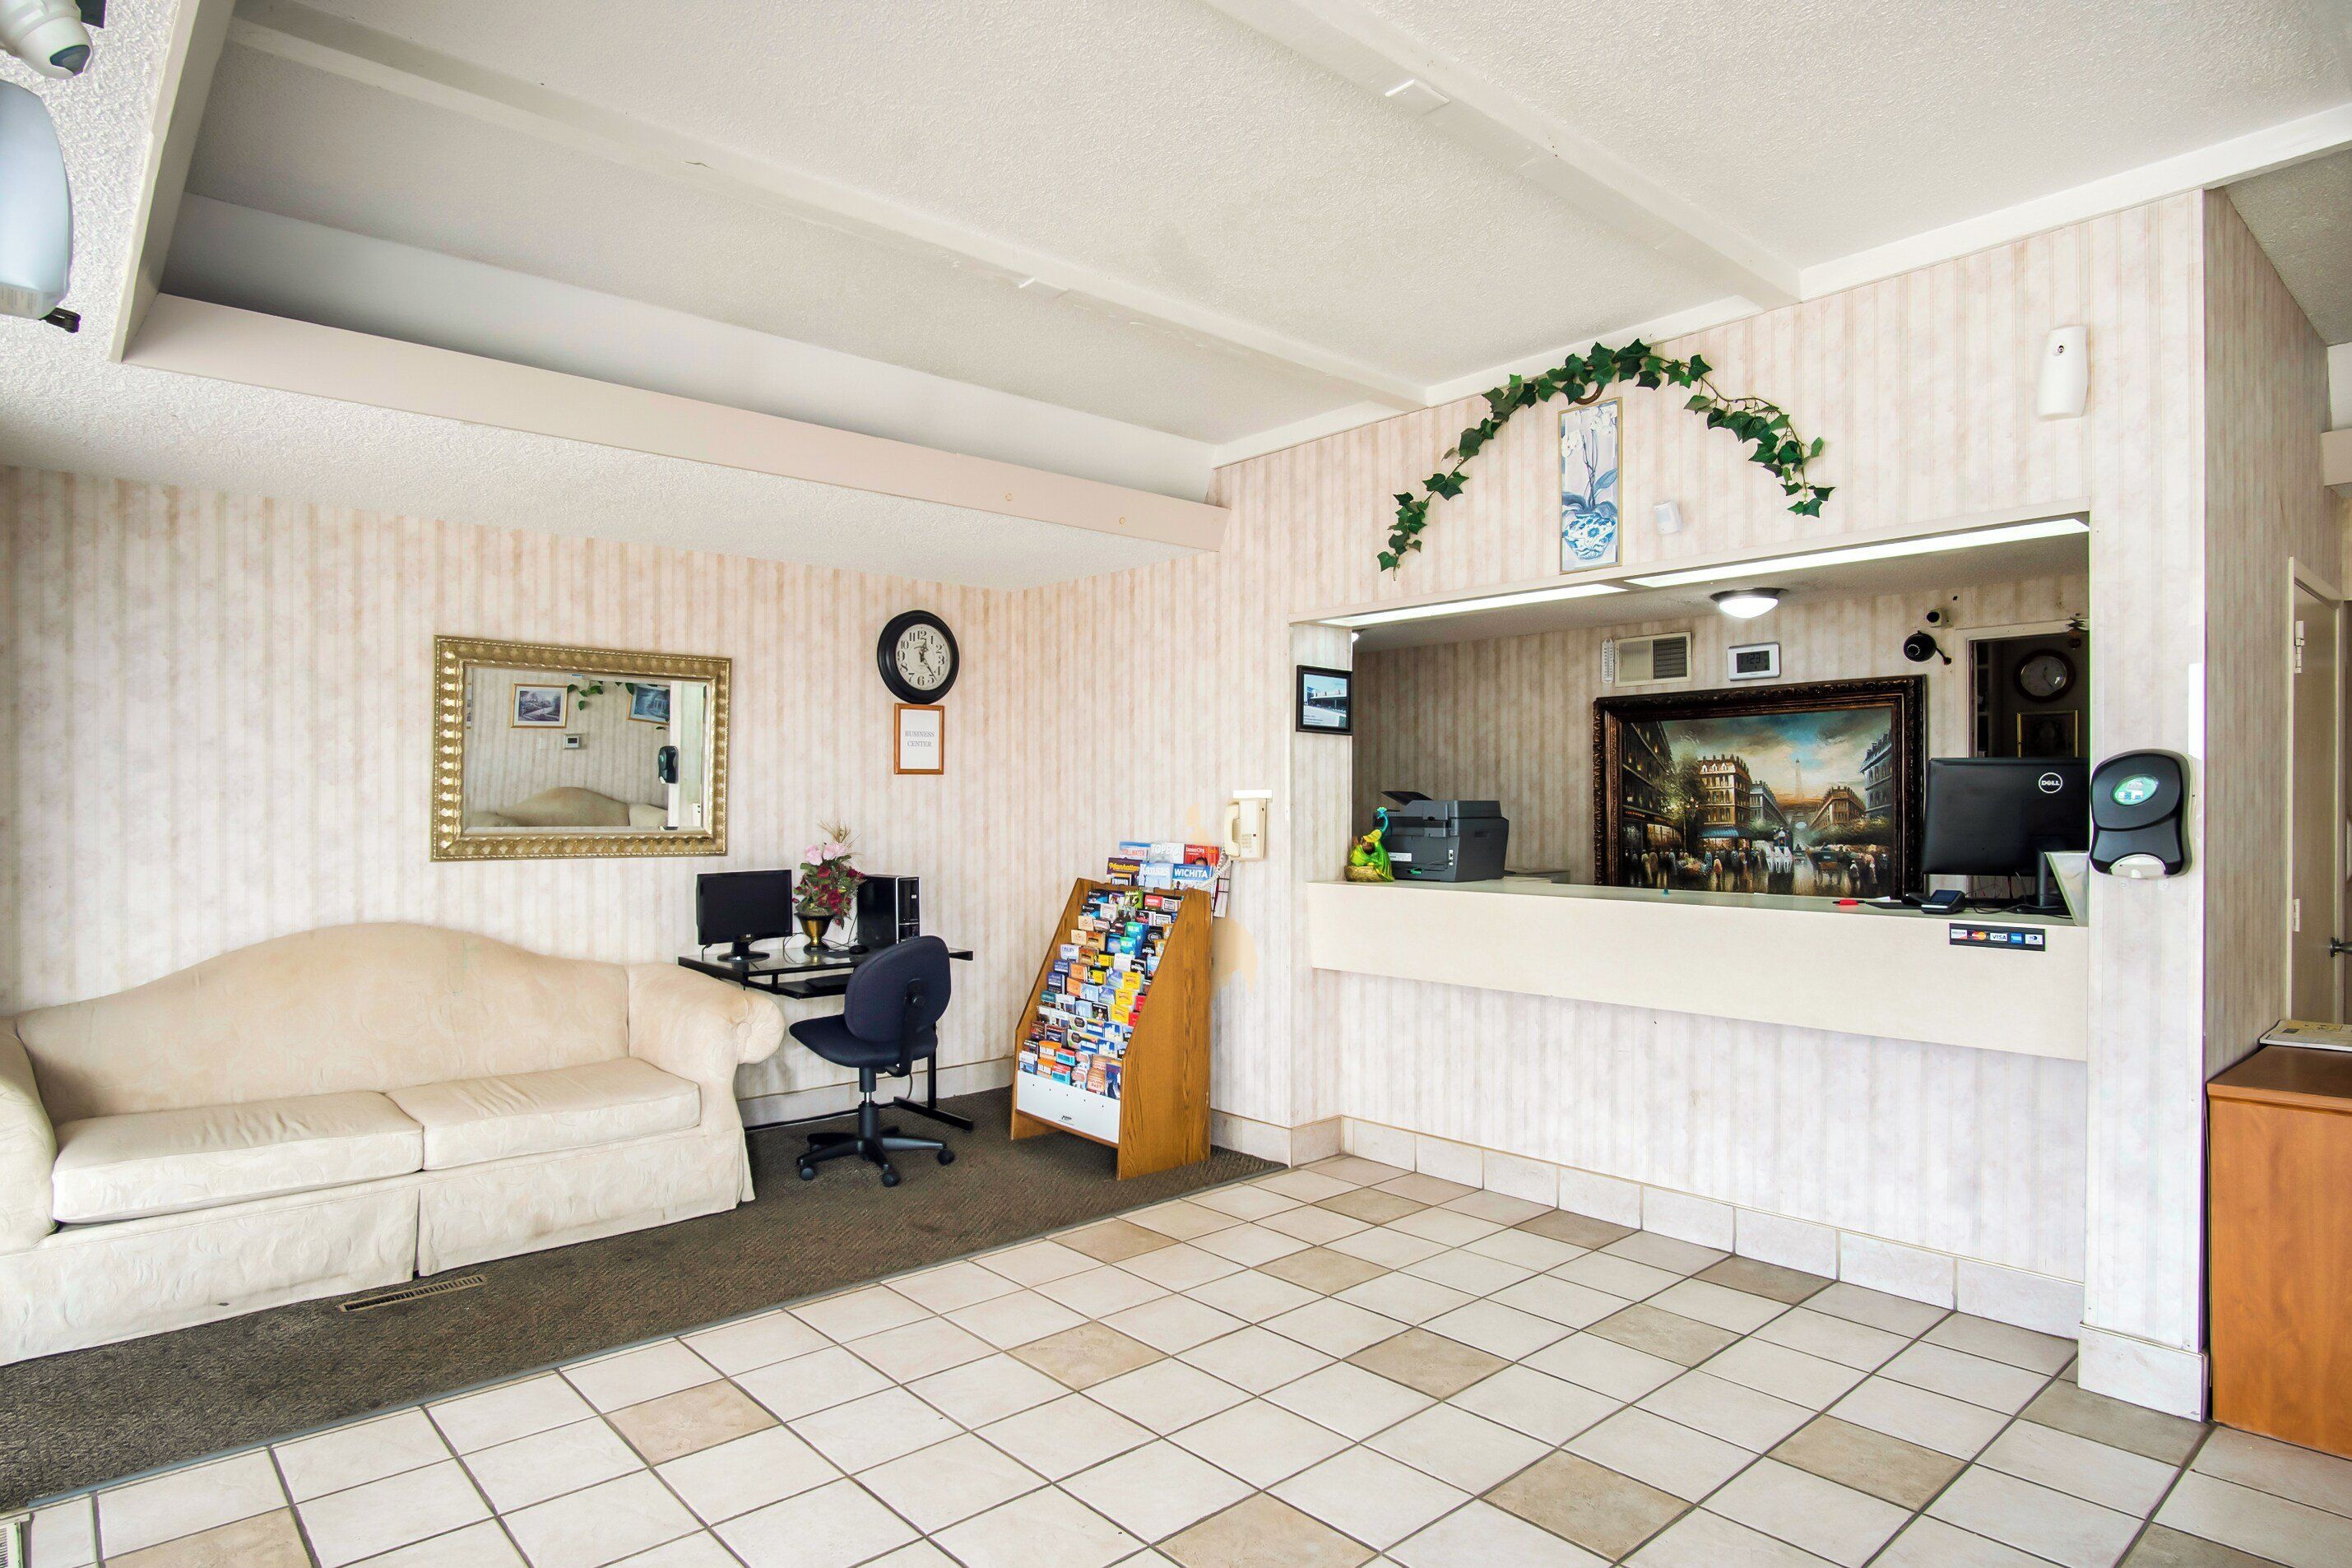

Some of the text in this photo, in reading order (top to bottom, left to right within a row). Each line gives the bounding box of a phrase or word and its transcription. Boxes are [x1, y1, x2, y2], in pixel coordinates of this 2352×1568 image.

[909, 632, 916, 642] 11
[917, 630, 926, 640] 12
[900, 640, 909, 649] 10
[935, 644, 943, 654] 2
[897, 650, 905, 661] 9
[938, 655, 944, 665] 3
[899, 661, 908, 672] 8
[908, 672, 916, 683] 7
[917, 675, 925, 686] 6
[1174, 868, 1208, 879] WICHITA
